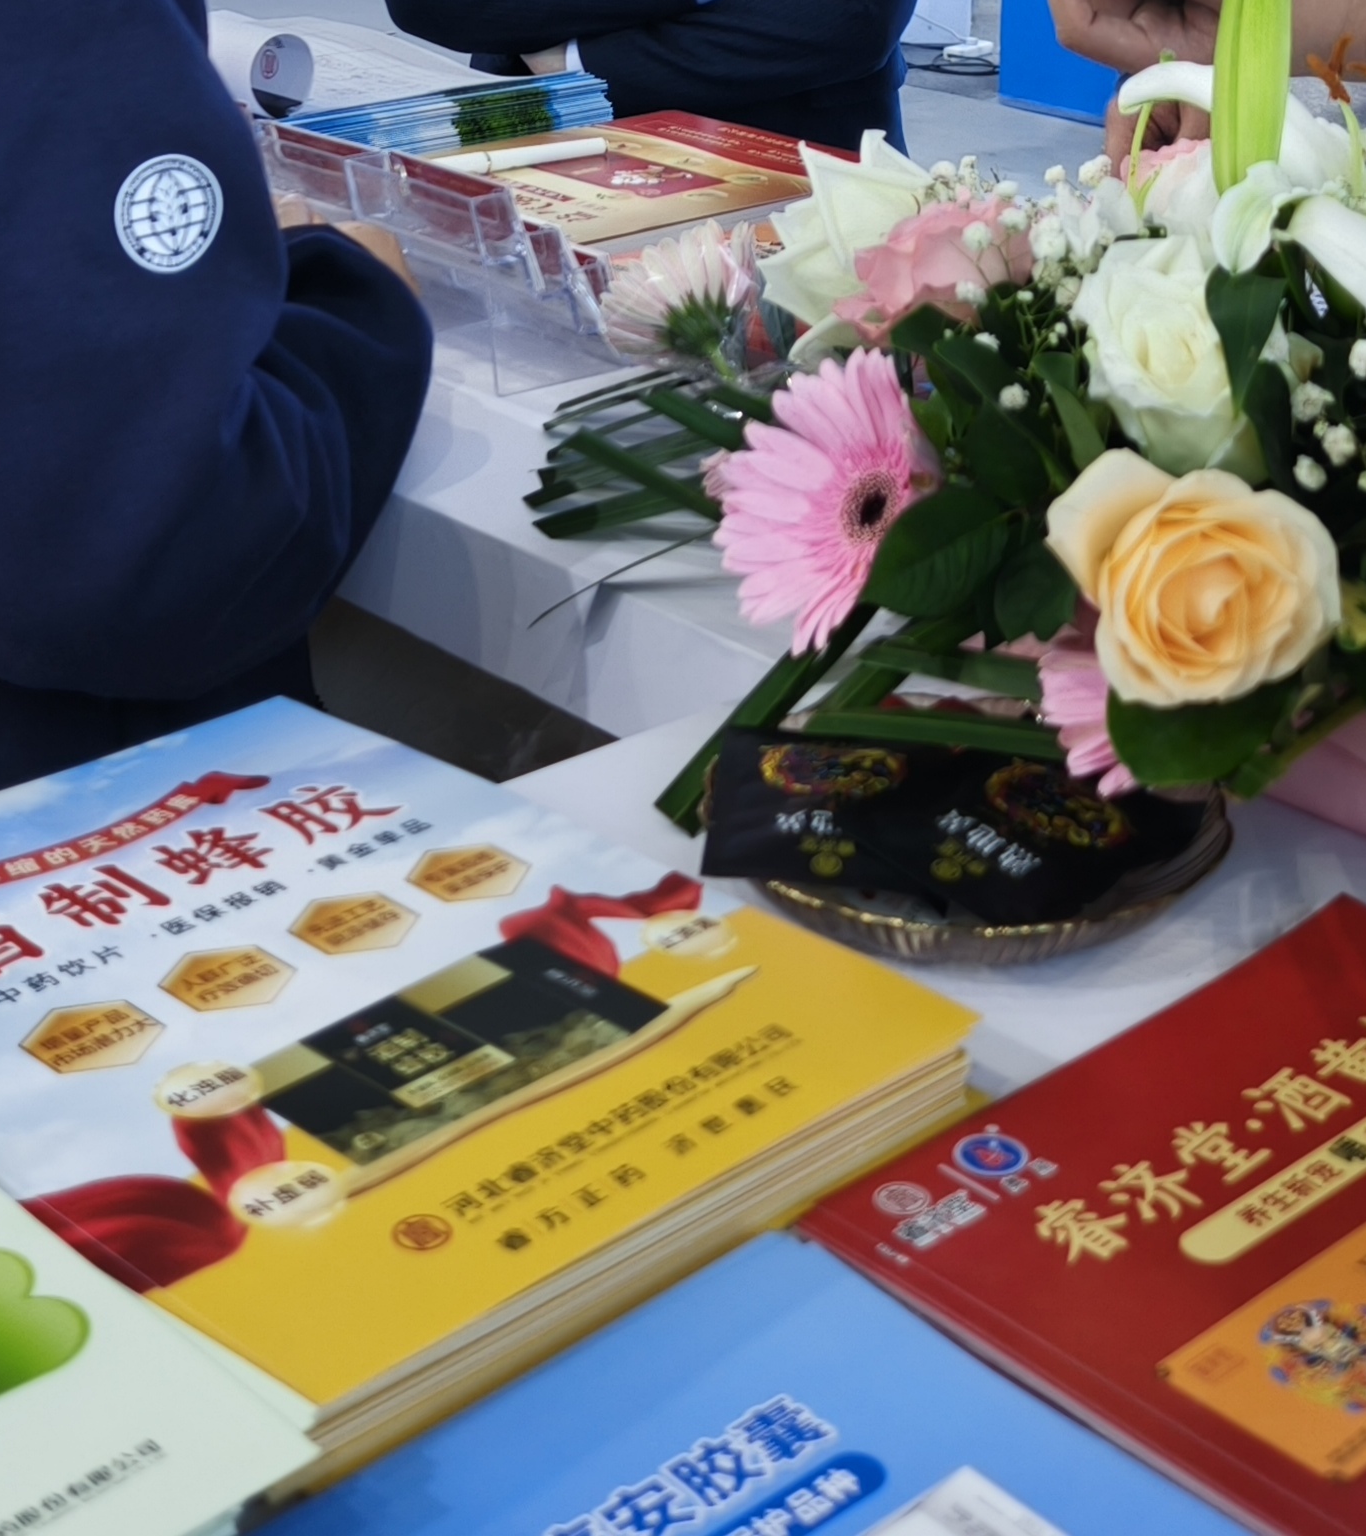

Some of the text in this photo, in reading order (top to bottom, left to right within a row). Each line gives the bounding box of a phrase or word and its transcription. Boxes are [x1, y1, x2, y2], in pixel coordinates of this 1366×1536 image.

[156, 877, 292, 936] 医保报销
[235, 1166, 336, 1220] 补虚弱
[551, 1395, 833, 1536] 安胶囊
